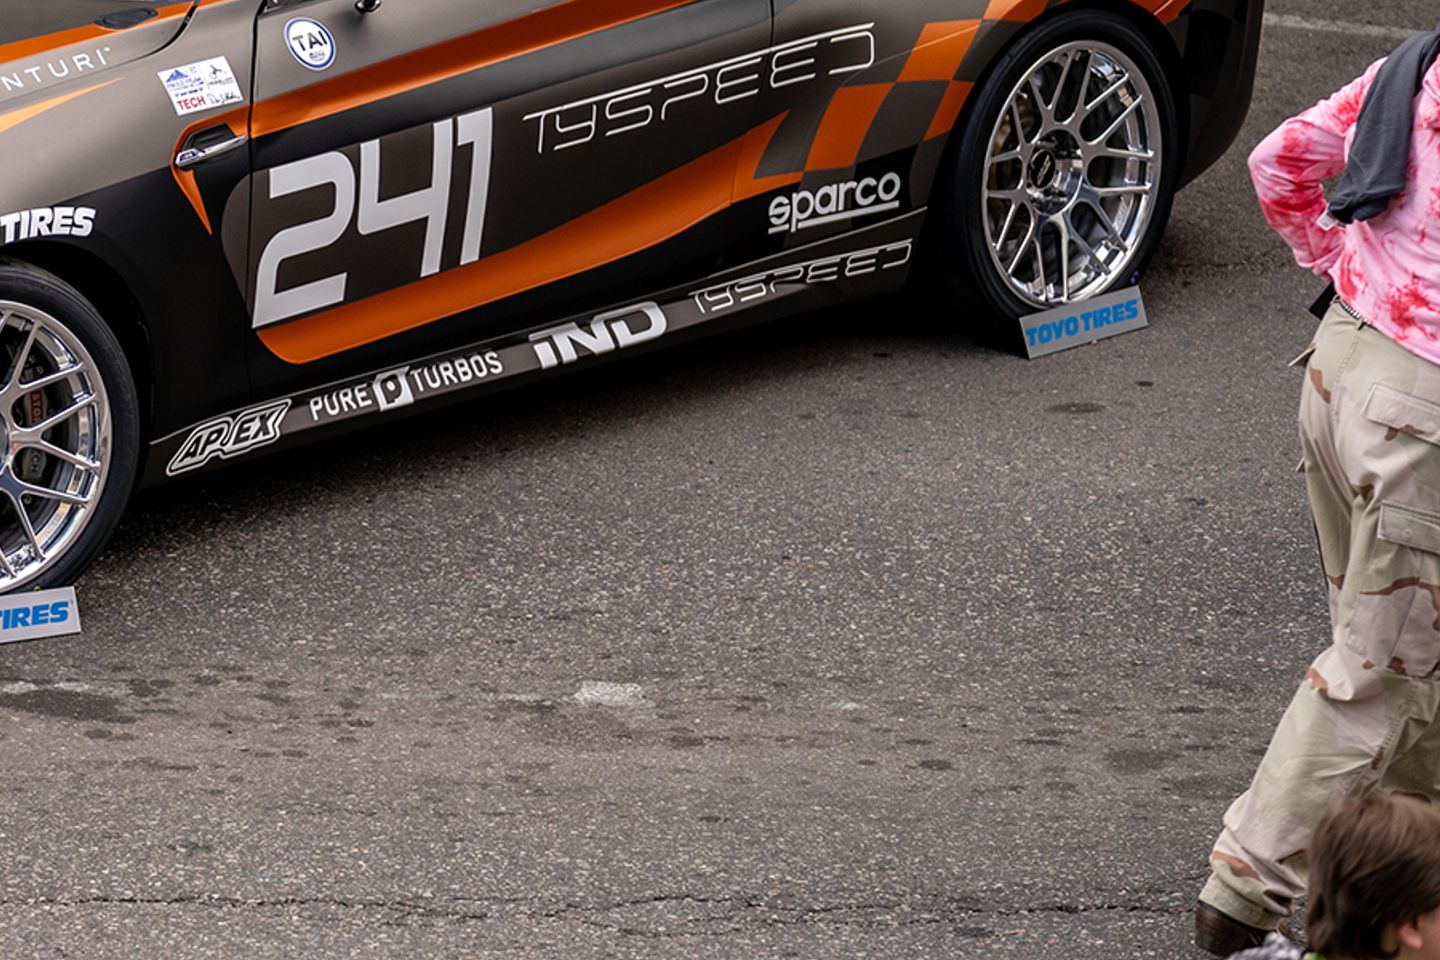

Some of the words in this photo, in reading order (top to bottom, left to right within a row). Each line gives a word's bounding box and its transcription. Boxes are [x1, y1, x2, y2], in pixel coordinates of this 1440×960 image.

[292, 30, 328, 51] TAI
[177, 95, 206, 111] TECH
[0, 206, 96, 243] TIRES
[252, 107, 493, 328] 241
[767, 172, 901, 234] sparco
[1025, 316, 1079, 347] TOYO
[1080, 299, 1139, 331] TIRES
[310, 384, 372, 421] PURE
[409, 350, 503, 393] TURBOS
